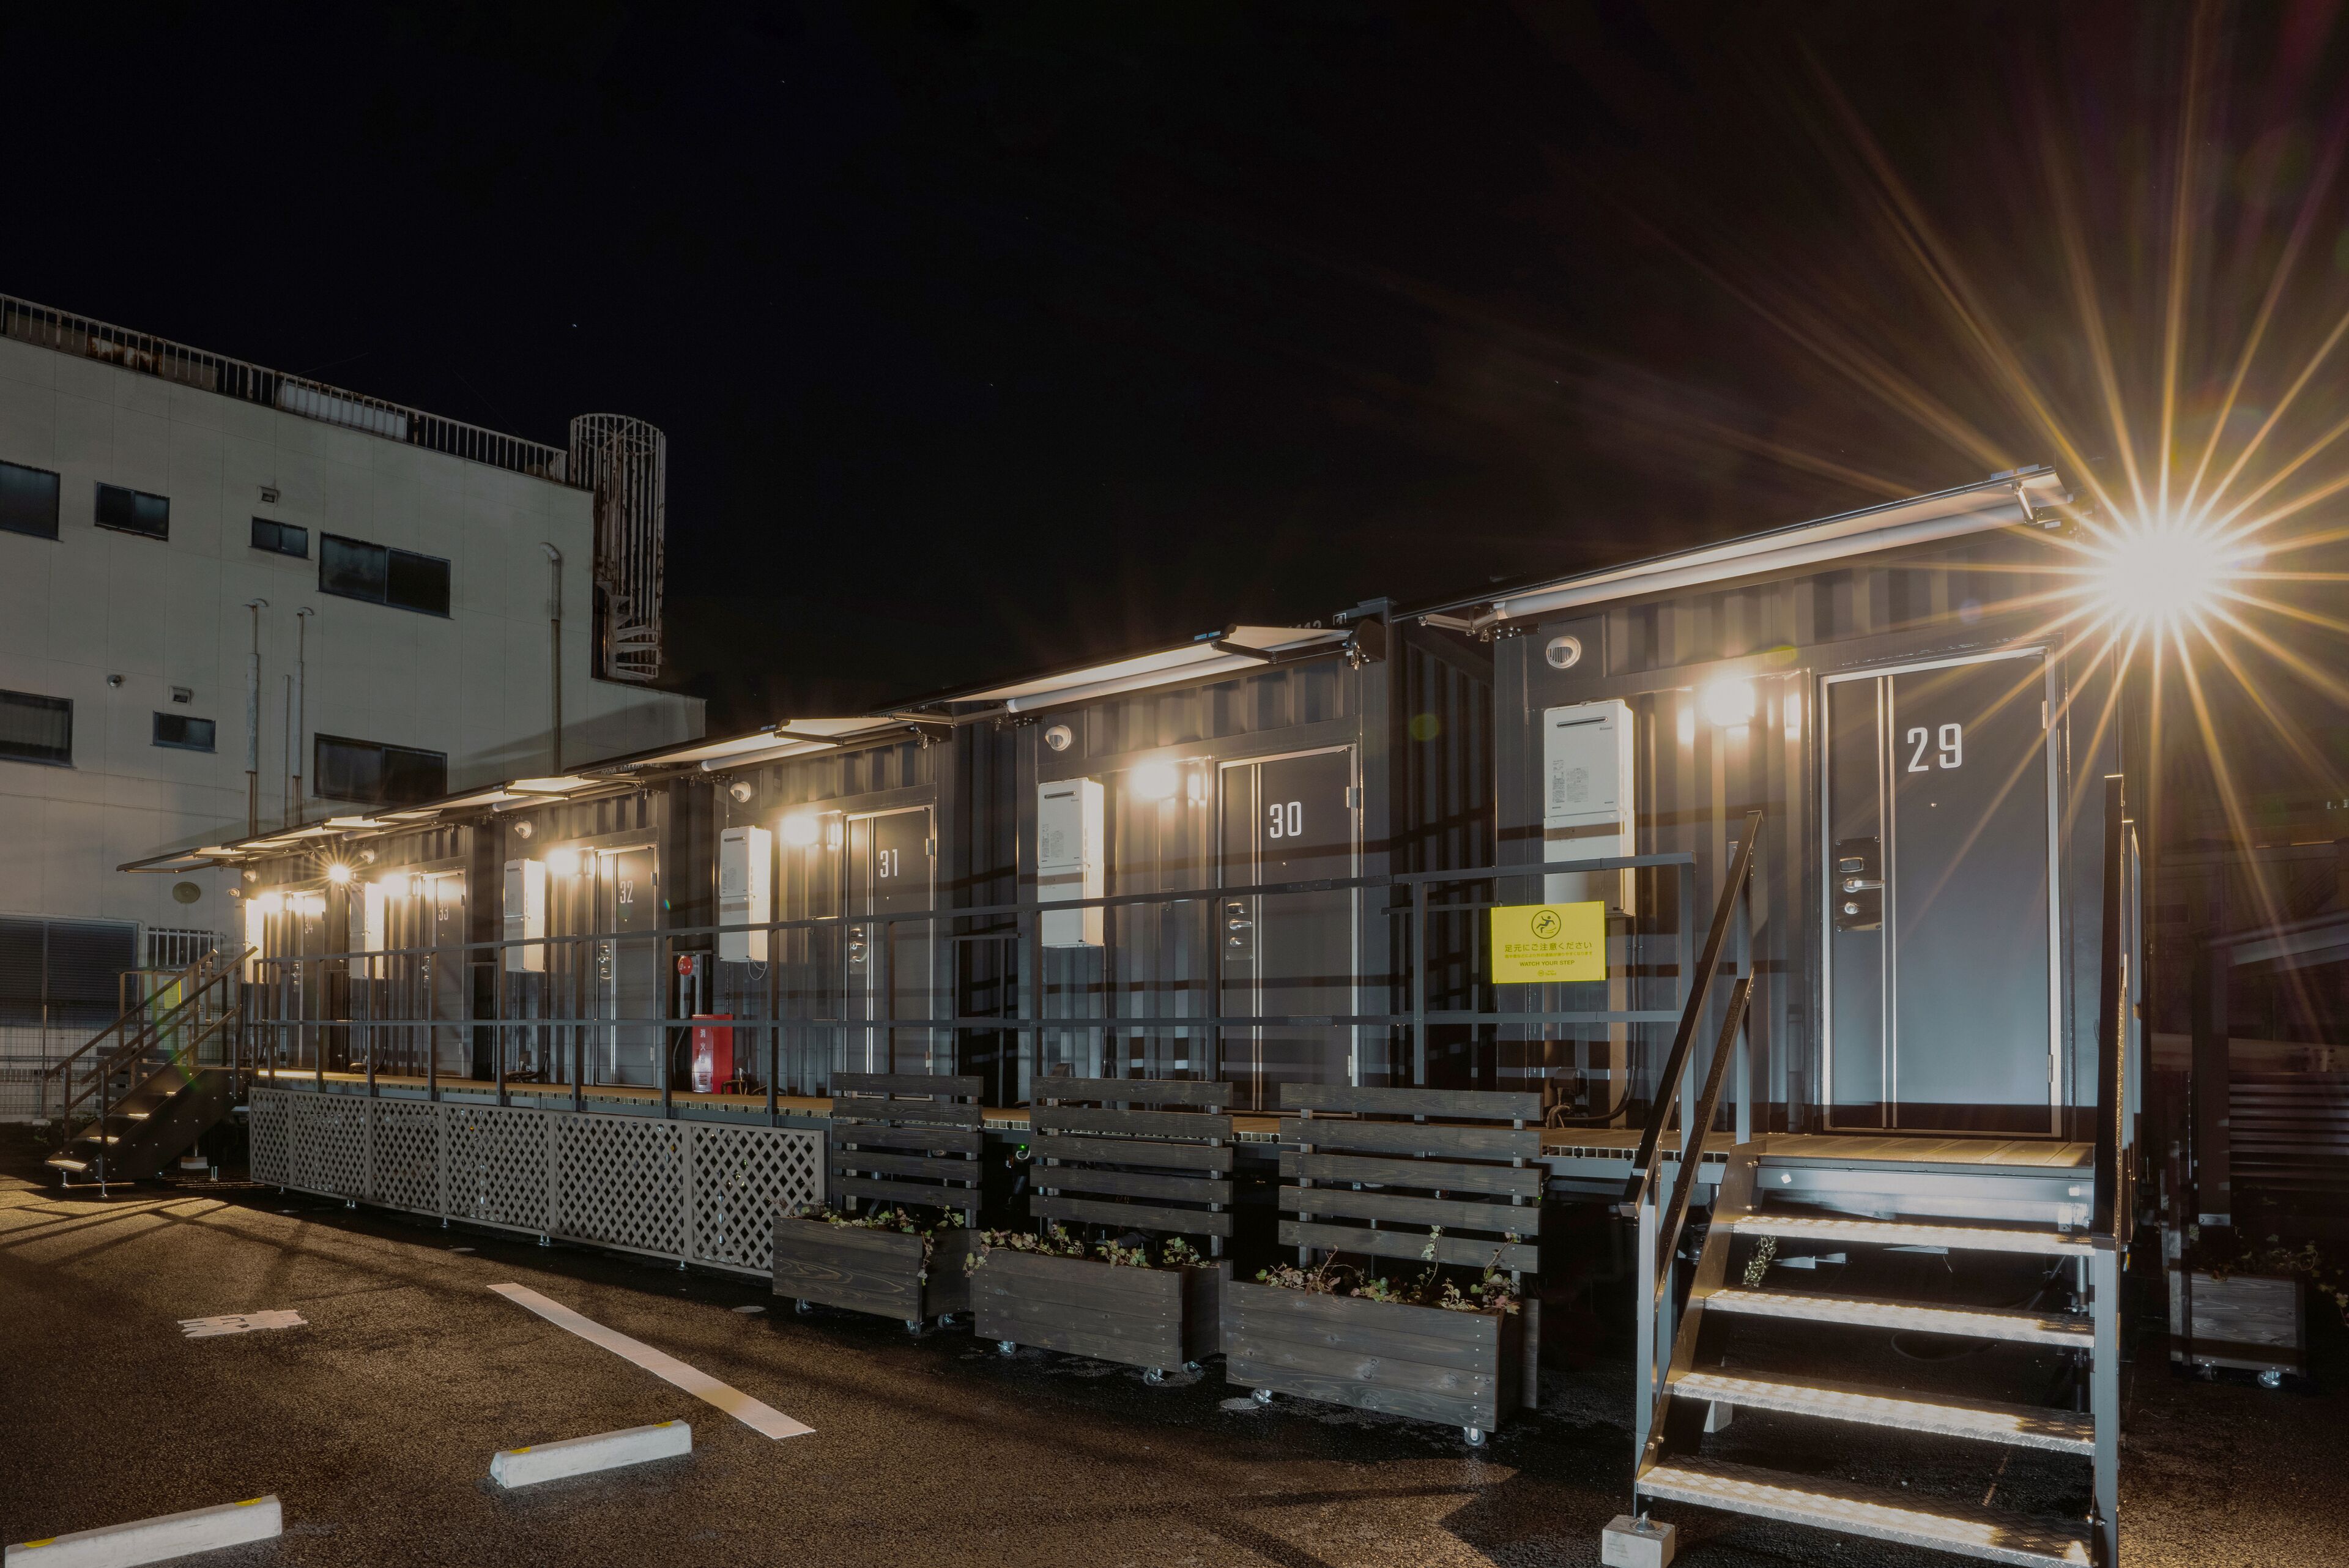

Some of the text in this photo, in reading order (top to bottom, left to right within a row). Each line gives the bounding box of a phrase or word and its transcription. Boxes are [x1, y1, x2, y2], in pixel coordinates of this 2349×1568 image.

[1907, 723, 1962, 773] 29
[1269, 801, 1302, 838] 30
[880, 849, 897, 878] 31
[620, 880, 633, 904] 32
[439, 901, 448, 921] 33
[305, 916, 313, 934] 34
[1505, 942, 1592, 953] 足元にご注意ください
